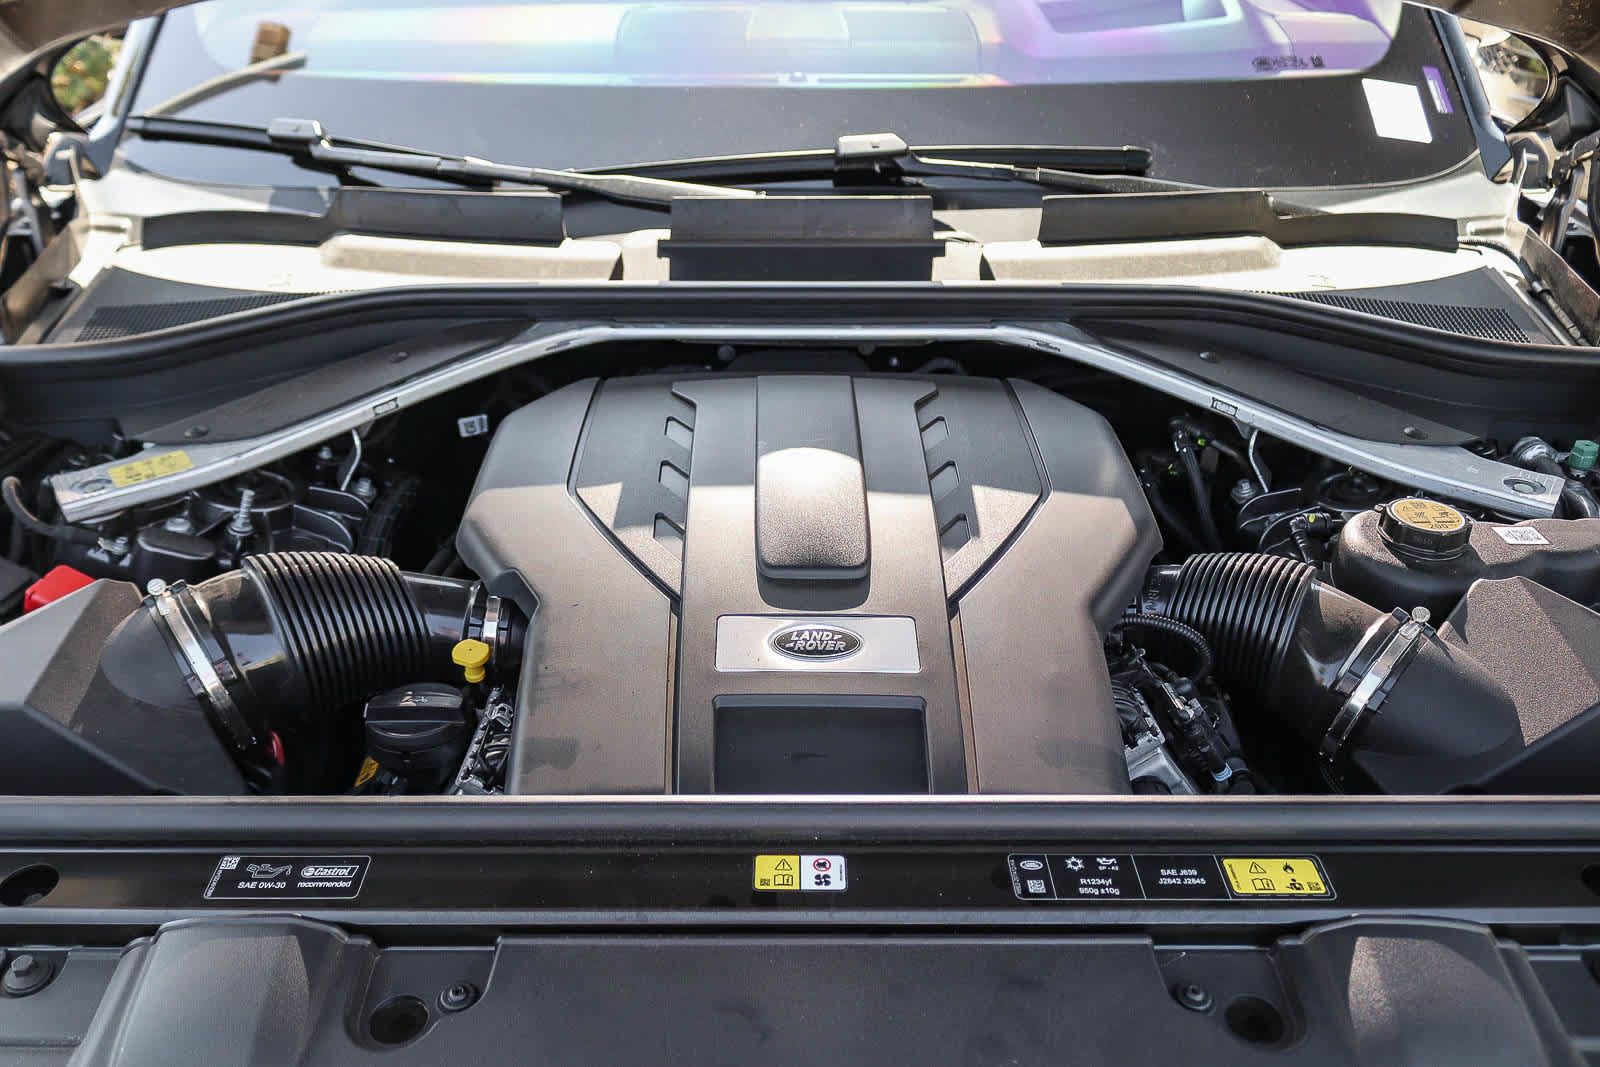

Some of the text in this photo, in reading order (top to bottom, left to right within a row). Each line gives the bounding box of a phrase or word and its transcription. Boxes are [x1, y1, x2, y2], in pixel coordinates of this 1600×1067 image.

[791, 631, 831, 641] LAND
[794, 640, 847, 651] ROVER
[314, 868, 351, 877] Castrol
[237, 881, 286, 889] SAE 0W-30
[297, 880, 351, 888] recommended
